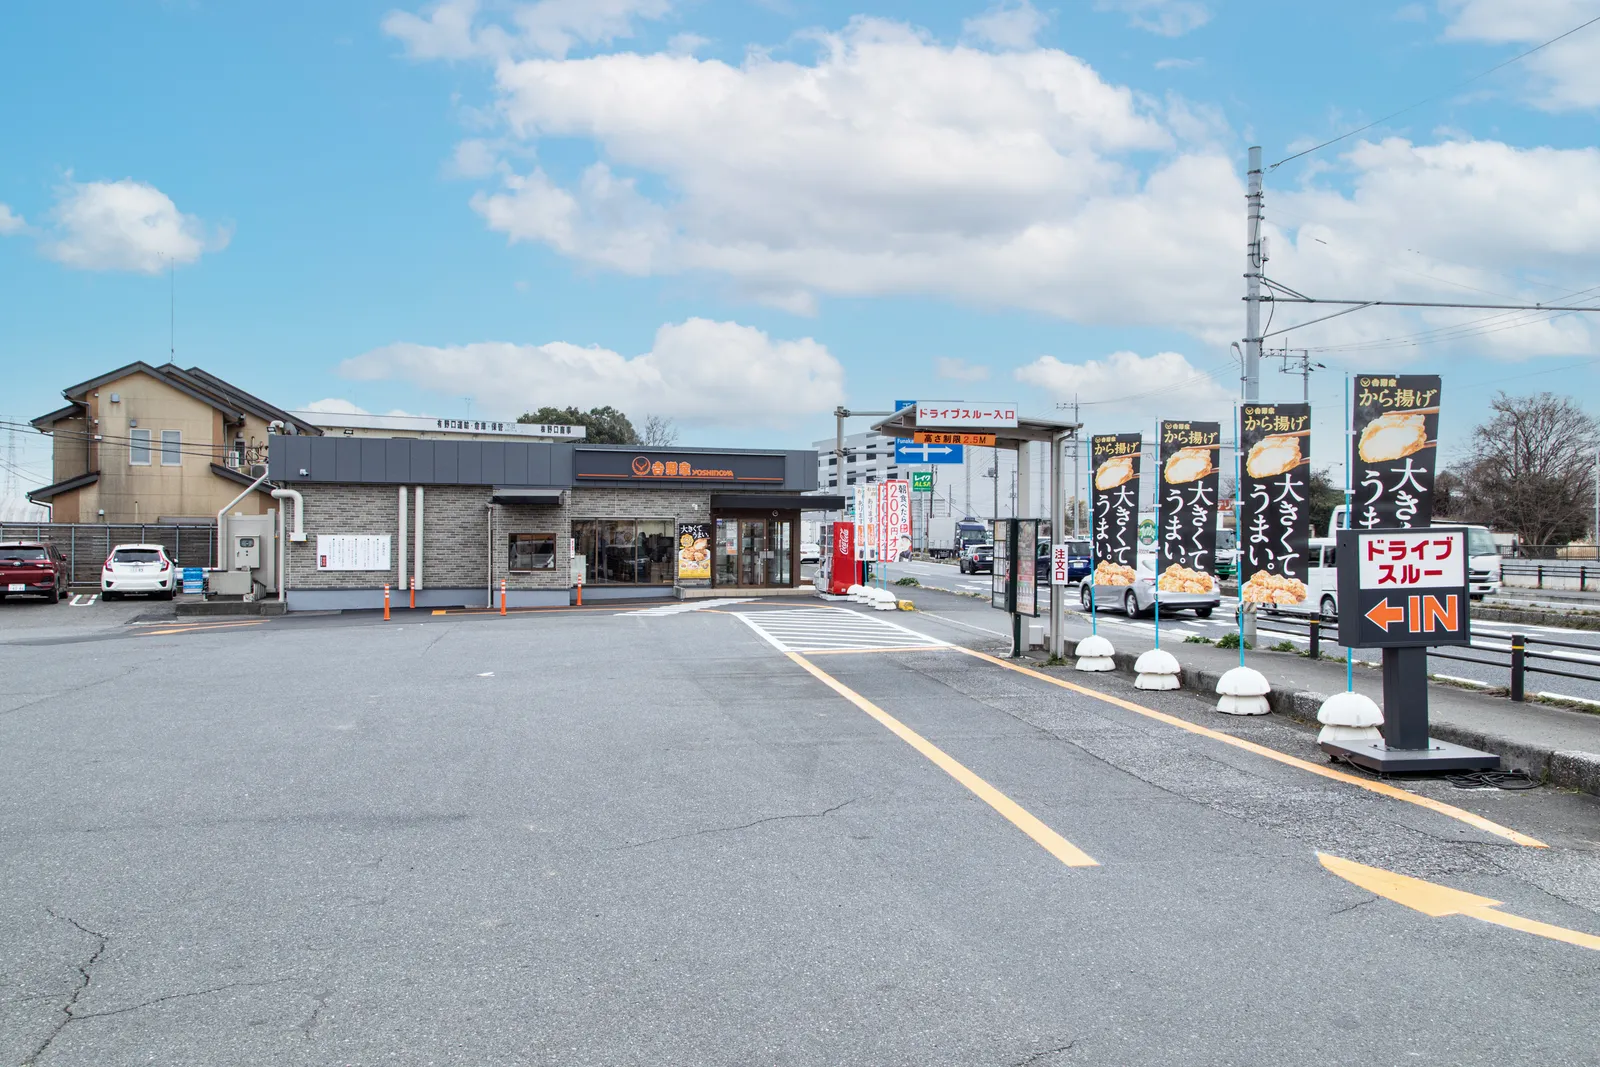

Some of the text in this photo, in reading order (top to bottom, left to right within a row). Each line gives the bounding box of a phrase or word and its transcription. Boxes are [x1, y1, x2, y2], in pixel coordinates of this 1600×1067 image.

[1358, 388, 1437, 408] から揚げ
[919, 408, 1015, 420] ドライブスルー入口
[1244, 415, 1308, 431] から揚げ
[924, 434, 987, 445] 高さ制限 2.5M
[1094, 441, 1139, 455] から揚げ
[1164, 430, 1218, 445] から揚げ
[652, 461, 734, 477] 吉野家 YOSHINOYA
[898, 484, 908, 523] 朝食べたら
[1388, 458, 1427, 528] 大き
[680, 525, 703, 534] 大きくて
[889, 484, 902, 559] 200円オフ
[1096, 494, 1112, 560] うまい。
[1112, 485, 1135, 564] 大きくて
[1164, 489, 1186, 564] うまい。
[1186, 480, 1214, 570] 大きくて
[1249, 484, 1275, 570] うまい。
[1273, 473, 1305, 576] 大きくて
[1367, 536, 1454, 561] ドライブ
[1055, 549, 1066, 580] 注文口
[1378, 564, 1442, 584] スルー
[1408, 595, 1459, 633] IN
